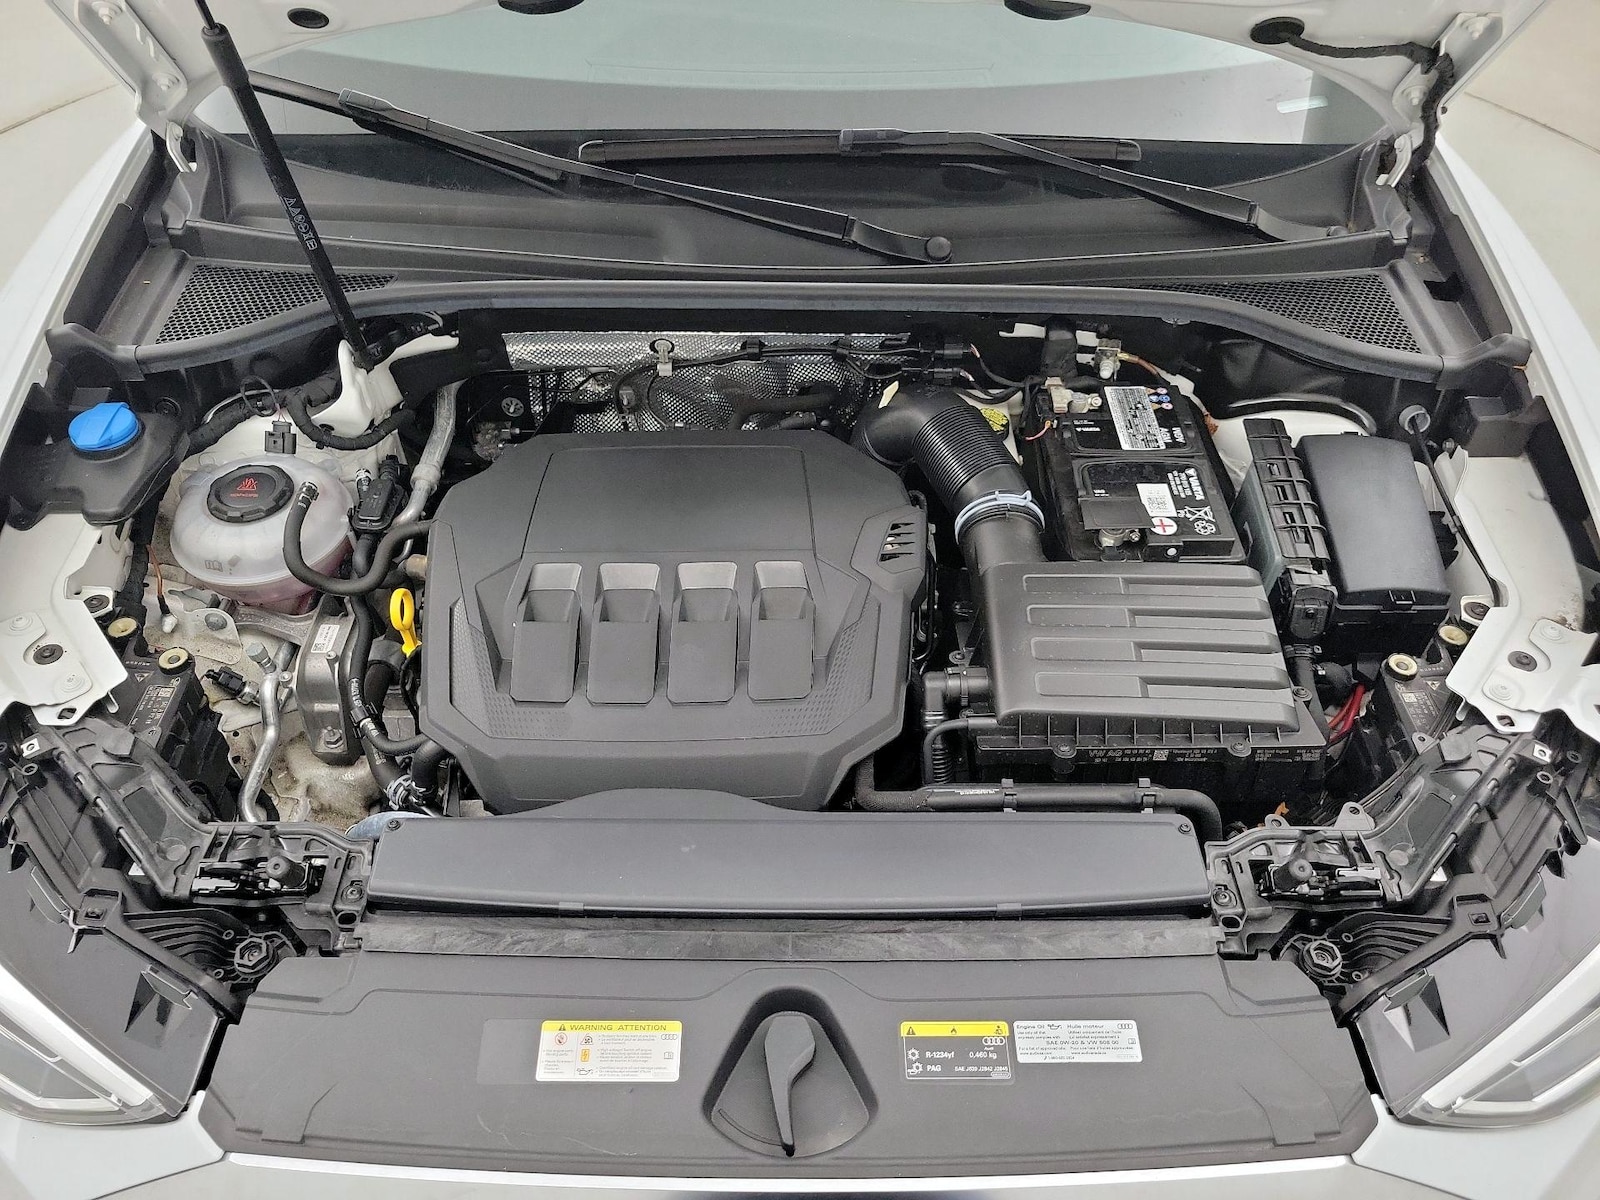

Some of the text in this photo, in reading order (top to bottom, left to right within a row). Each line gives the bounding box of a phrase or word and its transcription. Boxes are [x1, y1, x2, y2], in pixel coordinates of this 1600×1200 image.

[1188, 476, 1206, 501] VARTA
[1088, 749, 1106, 757] VW
[1106, 749, 1123, 757] AG
[925, 1051, 997, 1060] R-1234yf 0,460 kg
[926, 1064, 942, 1072] PAG
